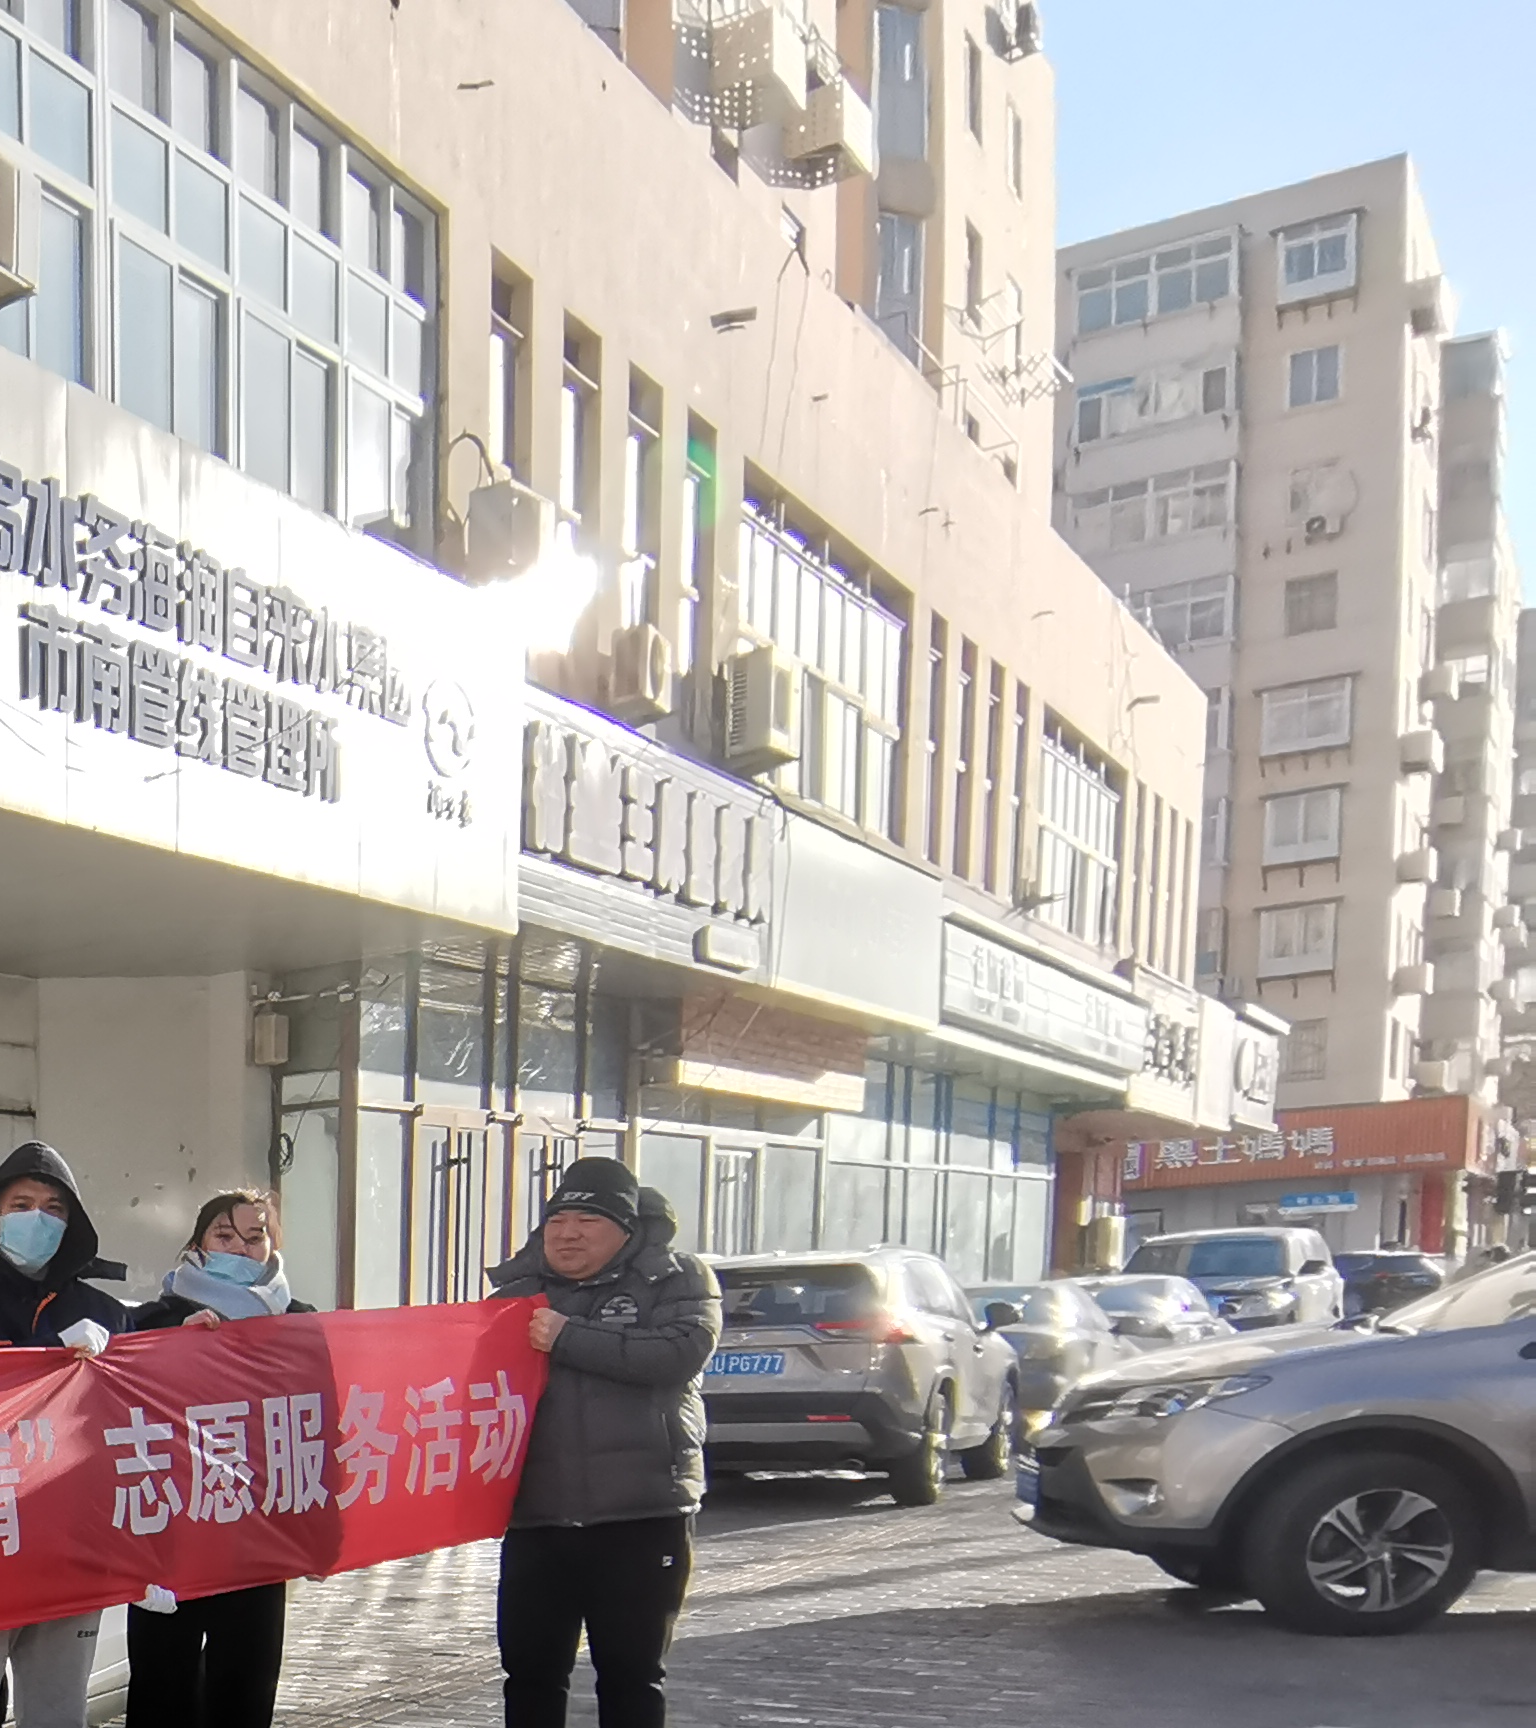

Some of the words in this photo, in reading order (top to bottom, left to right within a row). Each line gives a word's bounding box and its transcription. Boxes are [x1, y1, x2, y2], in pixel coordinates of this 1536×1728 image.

[16, 601, 342, 804] 市南管线管理所
[102, 1369, 527, 1536] 志愿服务活动
